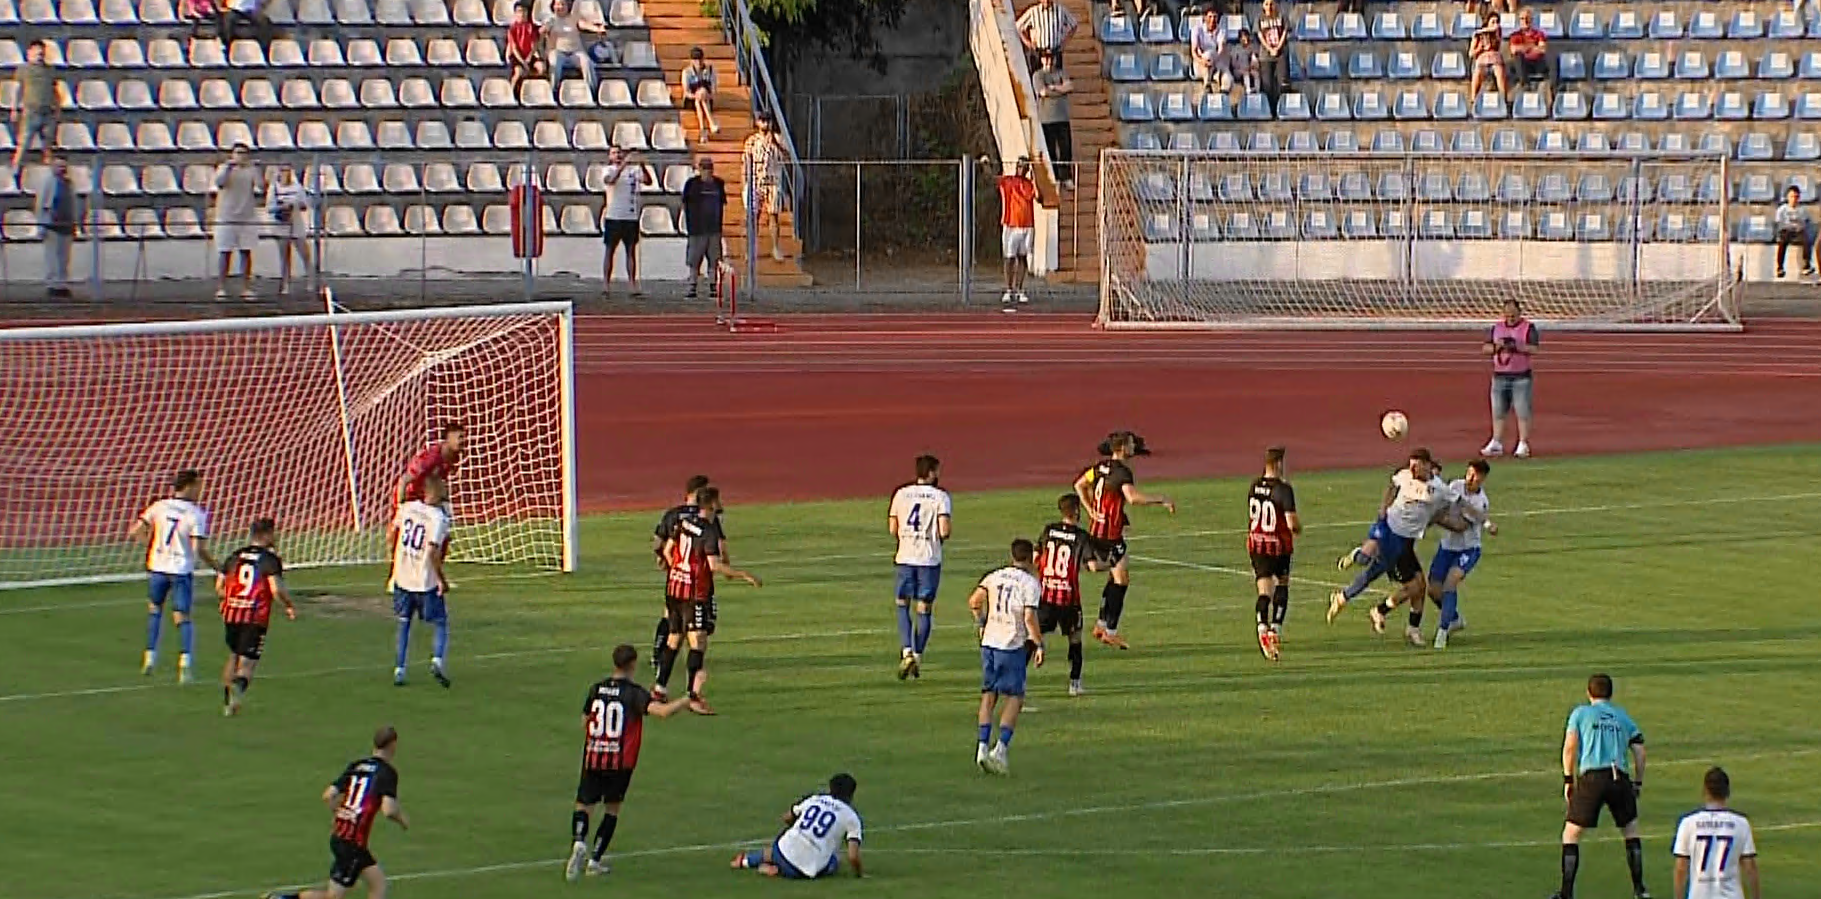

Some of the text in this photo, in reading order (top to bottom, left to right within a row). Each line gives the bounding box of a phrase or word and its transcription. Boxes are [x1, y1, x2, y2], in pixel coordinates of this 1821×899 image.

[166, 517, 179, 546] 7
[906, 503, 921, 532] 4
[1249, 497, 1277, 533] 90
[402, 518, 426, 550] 30
[1043, 541, 1071, 578] 18
[238, 563, 255, 596] 9
[996, 583, 1013, 614] 11
[589, 699, 624, 738] 30
[345, 775, 369, 814] 11
[800, 805, 836, 838] 99
[1696, 835, 1734, 872] 77
